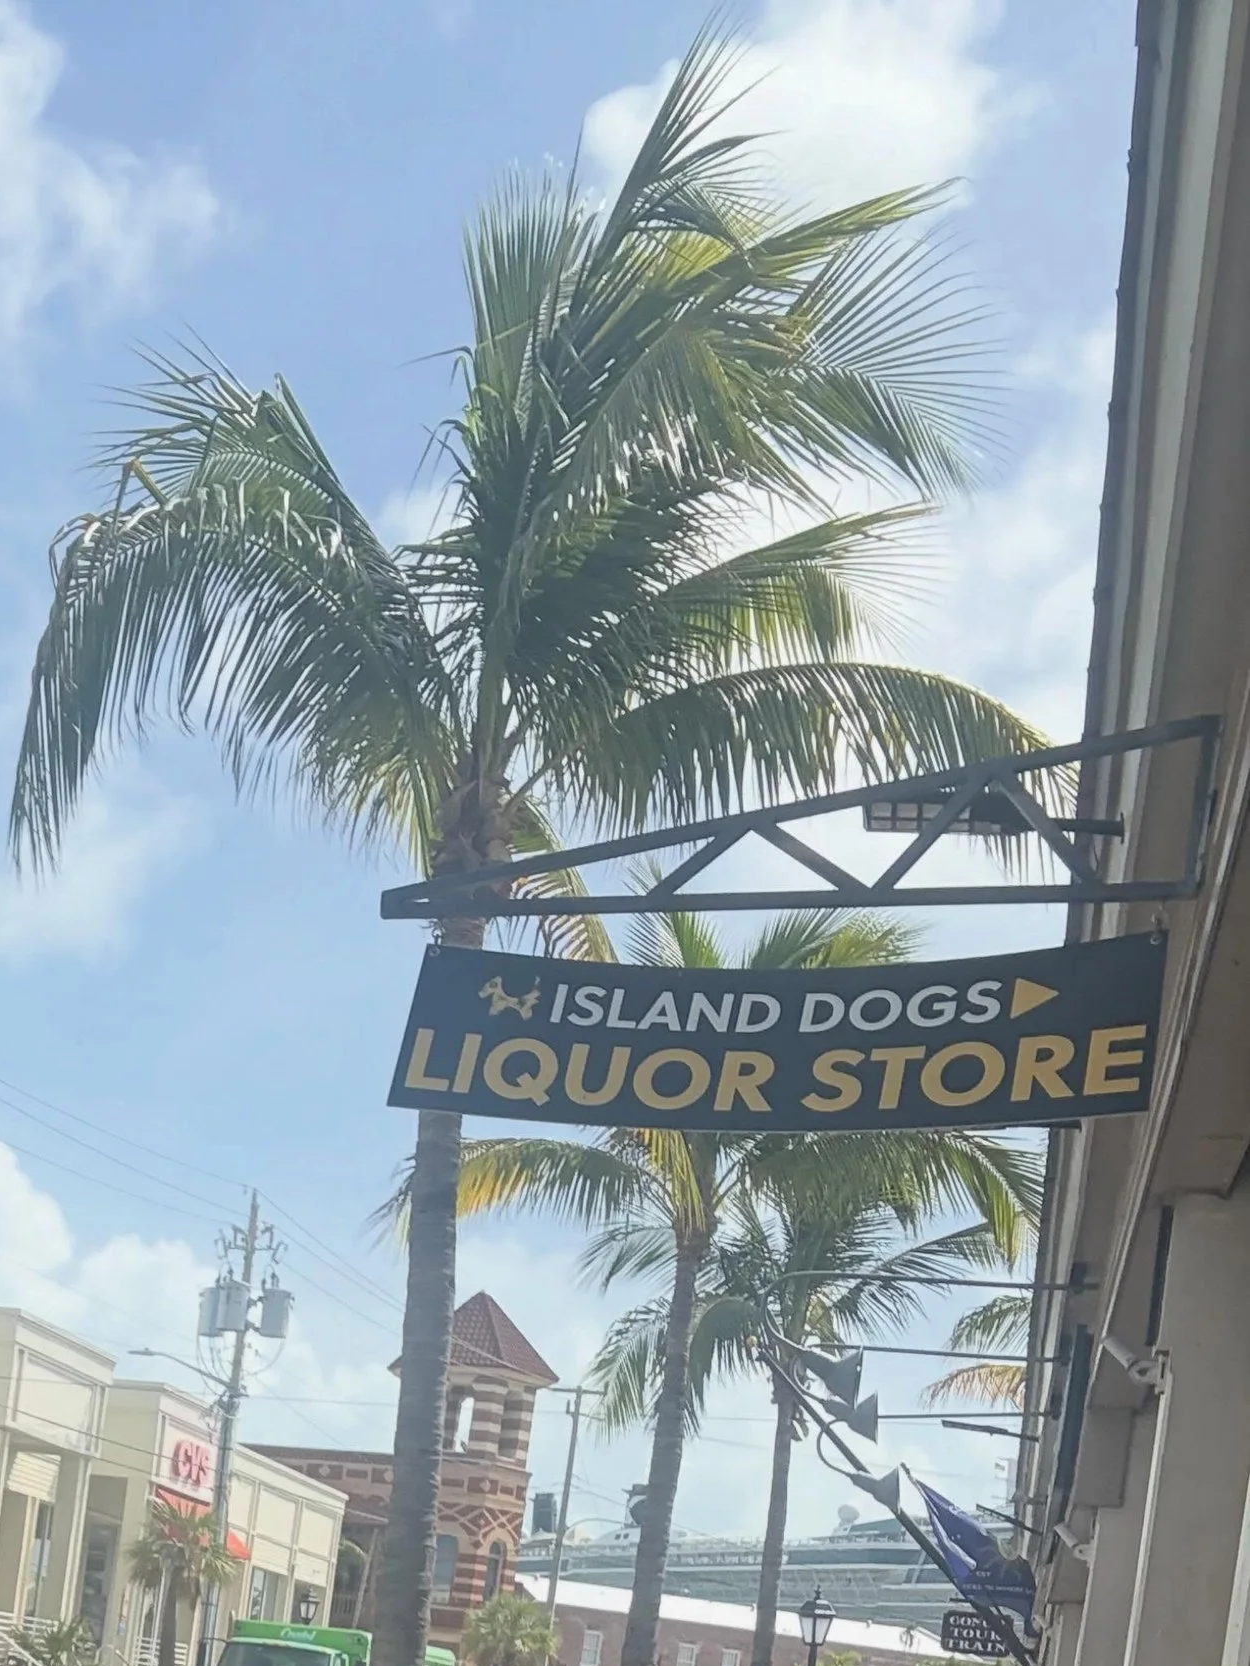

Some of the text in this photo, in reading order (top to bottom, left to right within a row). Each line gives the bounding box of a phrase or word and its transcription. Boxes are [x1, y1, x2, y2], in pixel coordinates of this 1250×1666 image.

[550, 980, 1002, 1033] ISLAND DOGS
[404, 1024, 1147, 1112] LIQUOR STORE
[947, 1638, 1005, 1652] TRAIN
